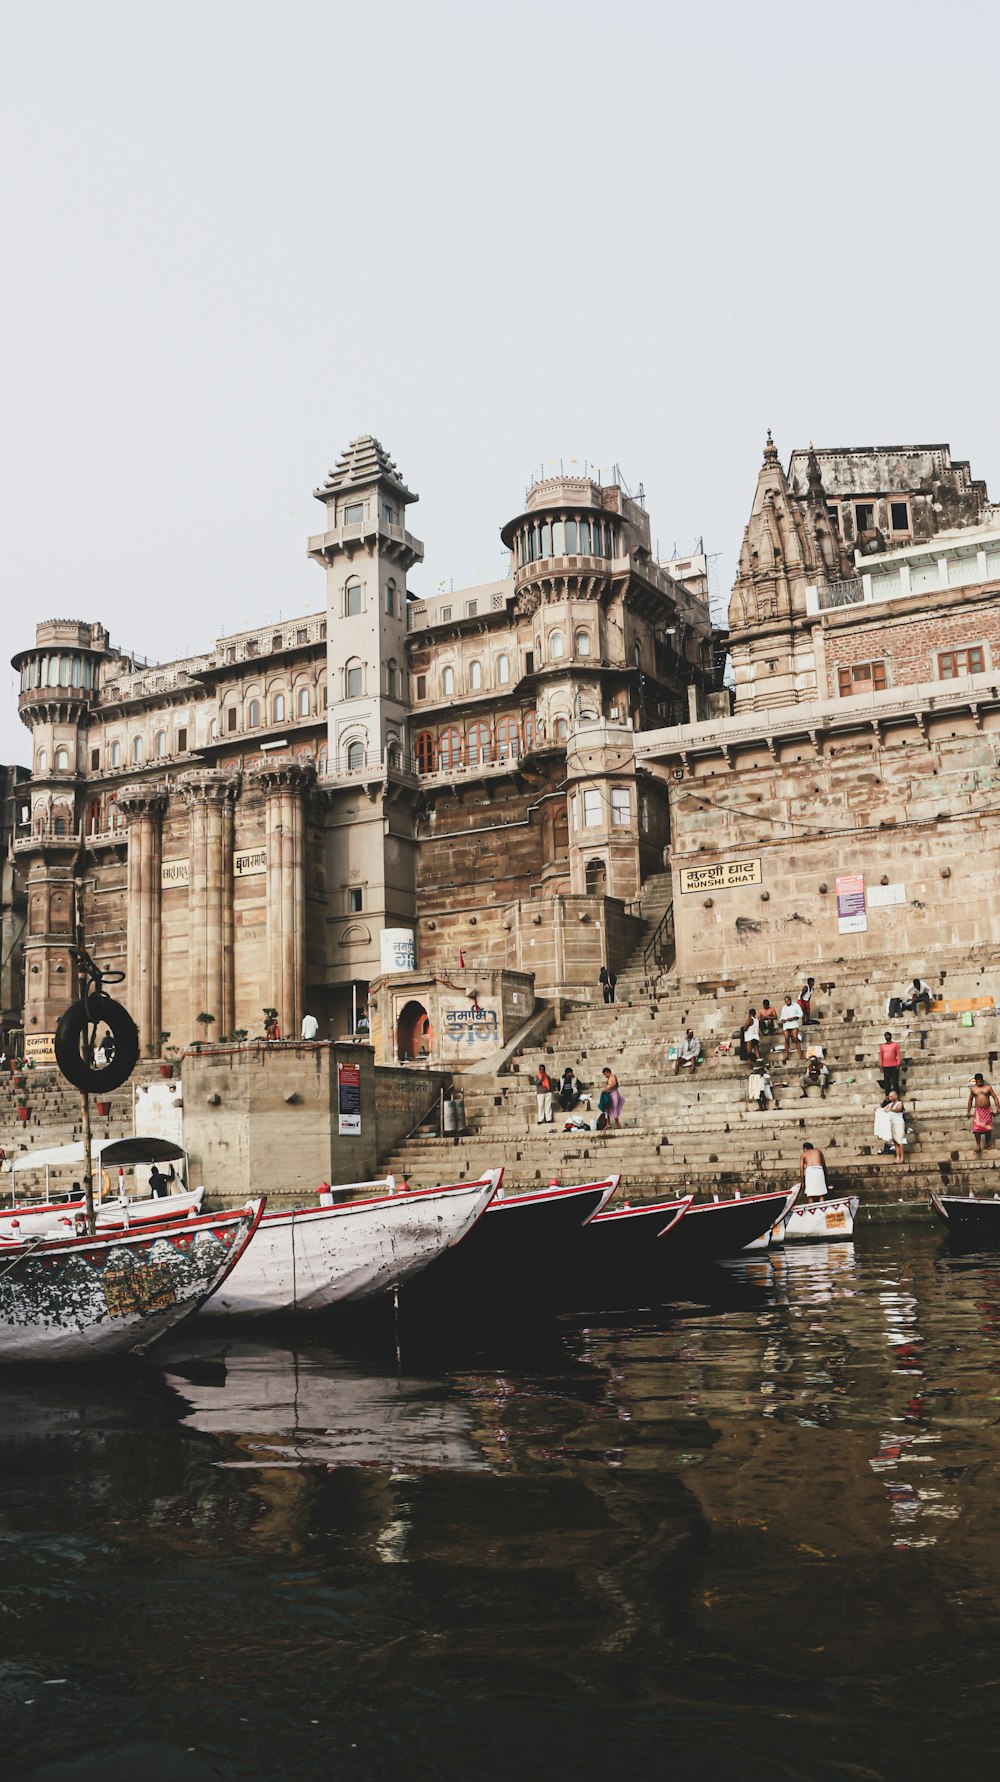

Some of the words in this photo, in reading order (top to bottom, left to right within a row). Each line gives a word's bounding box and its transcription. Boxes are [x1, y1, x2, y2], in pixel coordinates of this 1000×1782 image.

[728, 862, 754, 875] घाट
[687, 878, 724, 889] MUNSHI
[728, 874, 755, 884] GHAT
